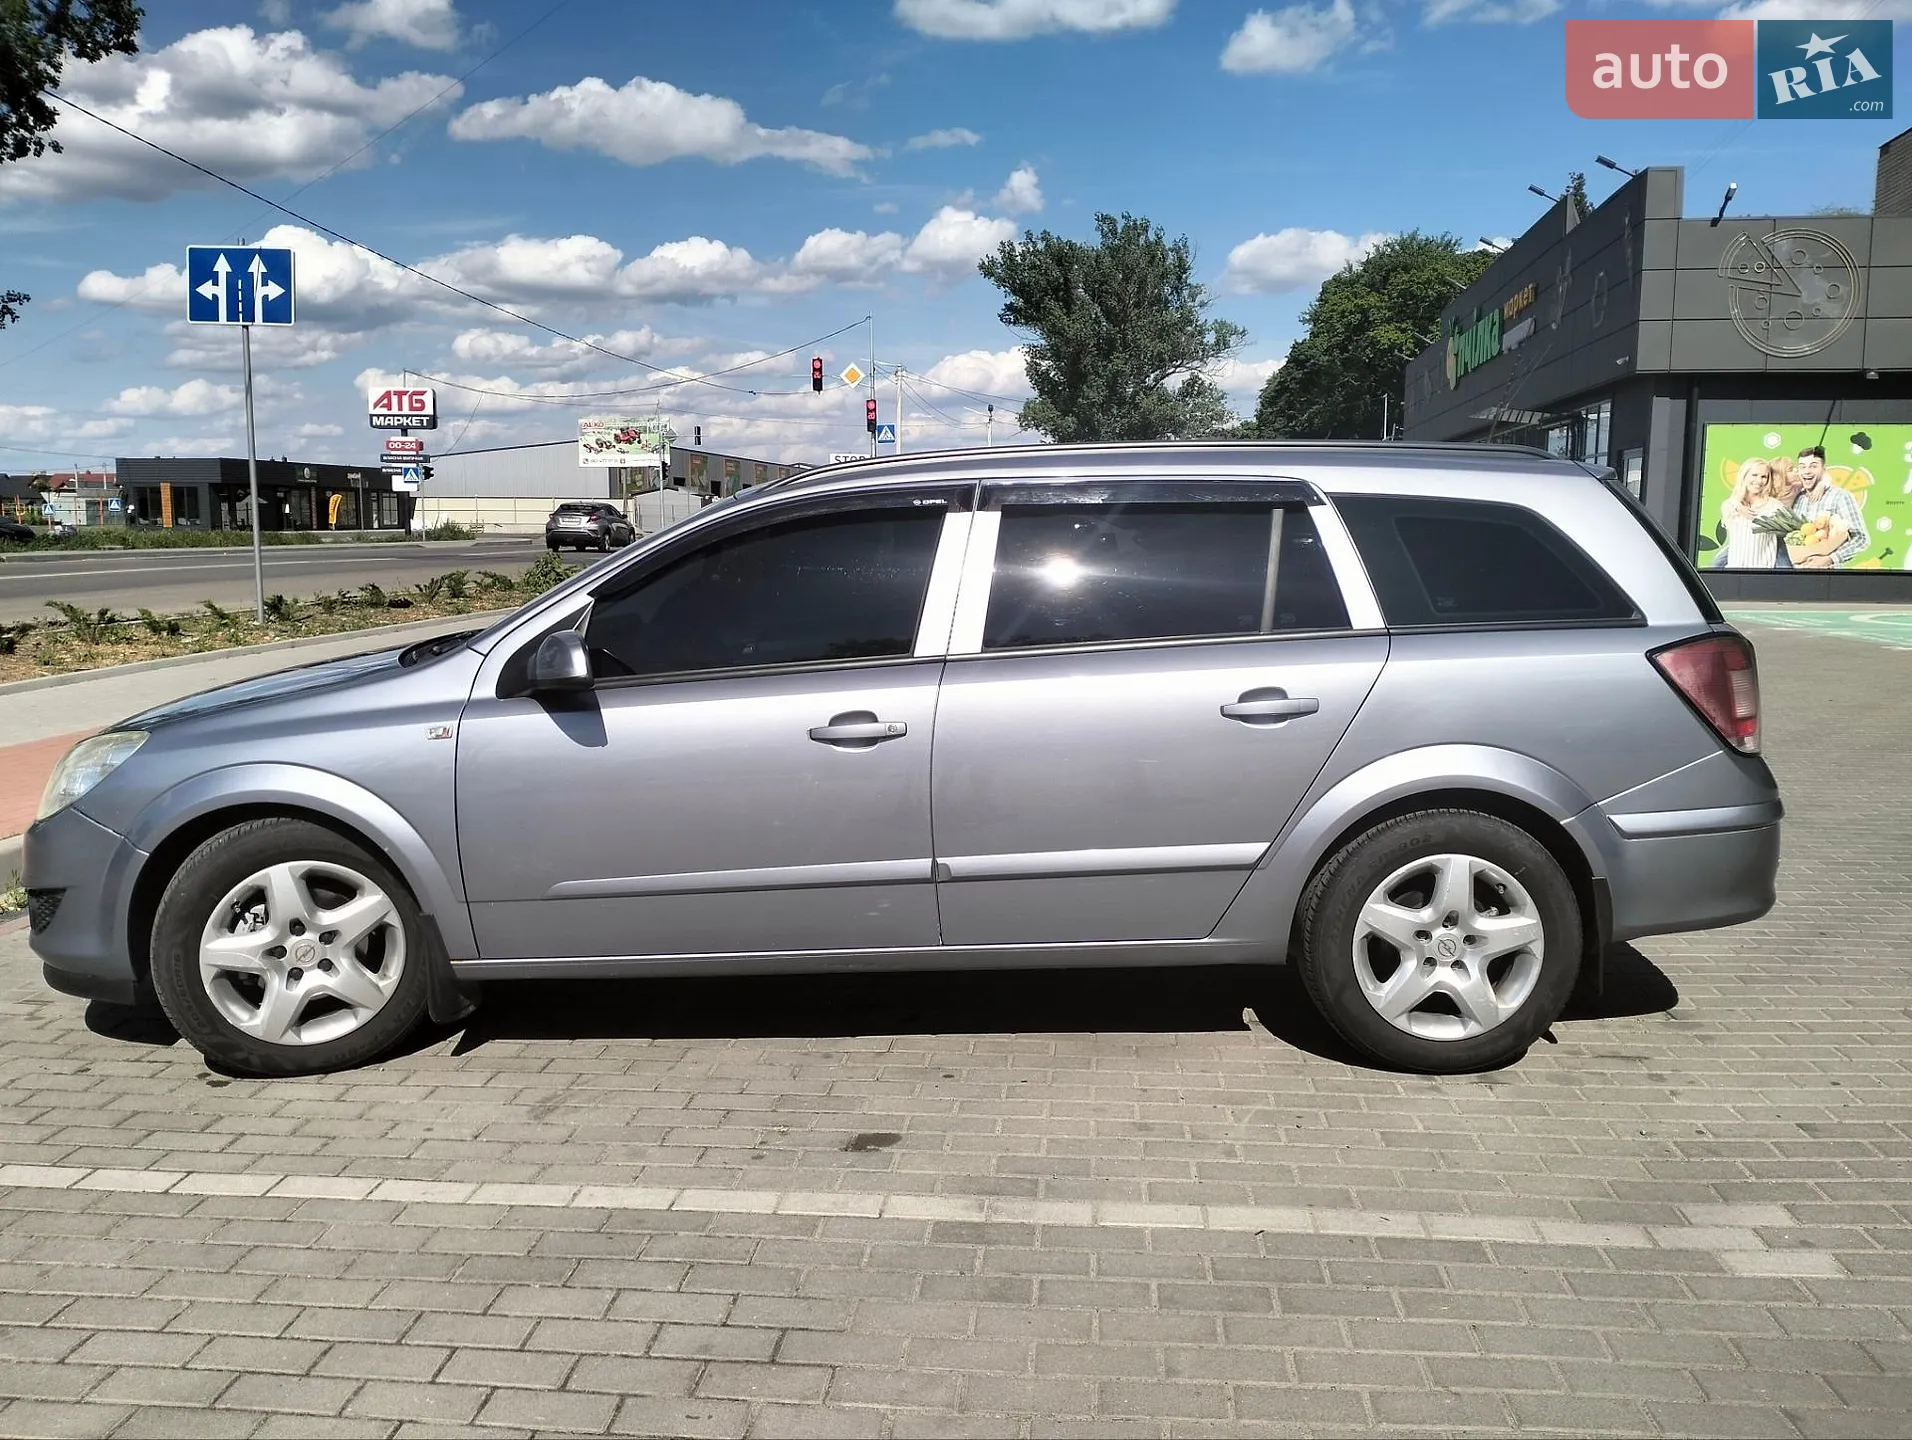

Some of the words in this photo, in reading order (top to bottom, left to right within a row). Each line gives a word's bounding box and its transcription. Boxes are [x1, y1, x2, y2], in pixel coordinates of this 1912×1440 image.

[373, 390, 428, 412] АТБ
[372, 416, 430, 427] МАРКЕТ
[388, 441, 417, 450] 00-24
